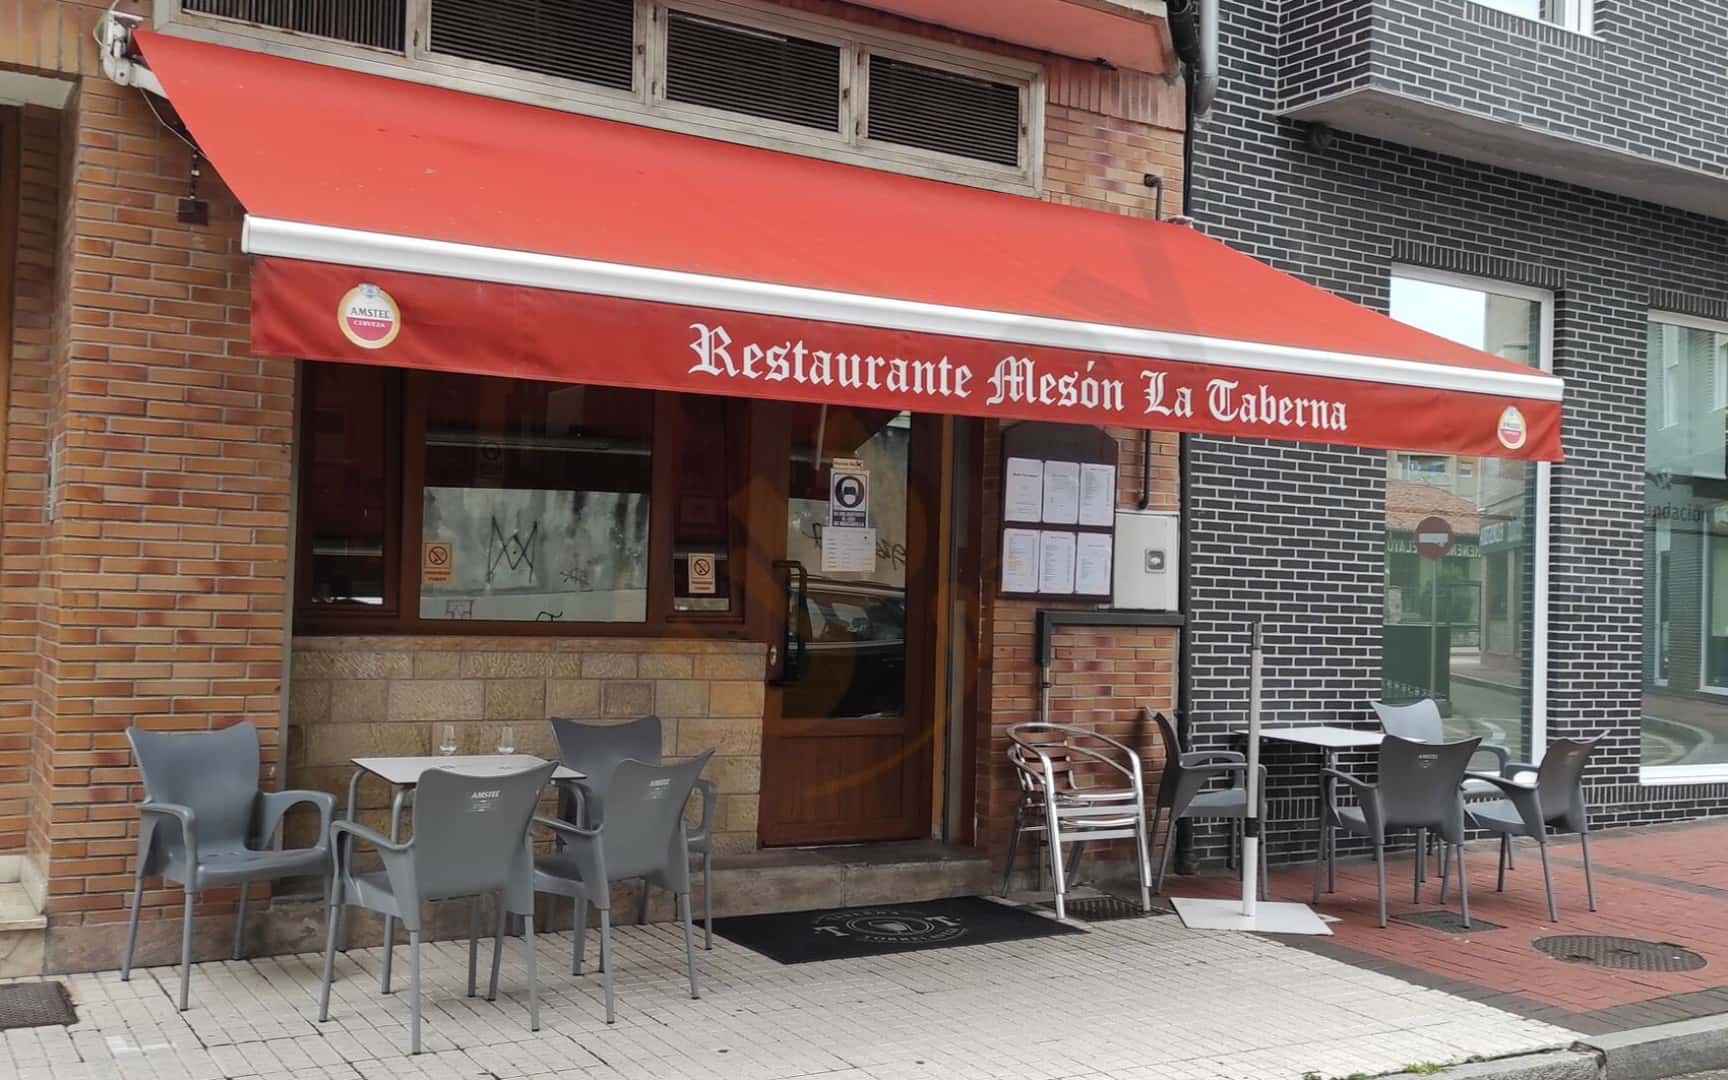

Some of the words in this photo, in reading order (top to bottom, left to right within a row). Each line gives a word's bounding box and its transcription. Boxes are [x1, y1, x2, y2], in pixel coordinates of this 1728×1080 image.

[351, 306, 390, 318] AMSTEL
[688, 323, 972, 398] Restaurante
[986, 355, 1125, 412] Mesón
[1140, 370, 1194, 418] La
[1206, 378, 1349, 431] Taberna
